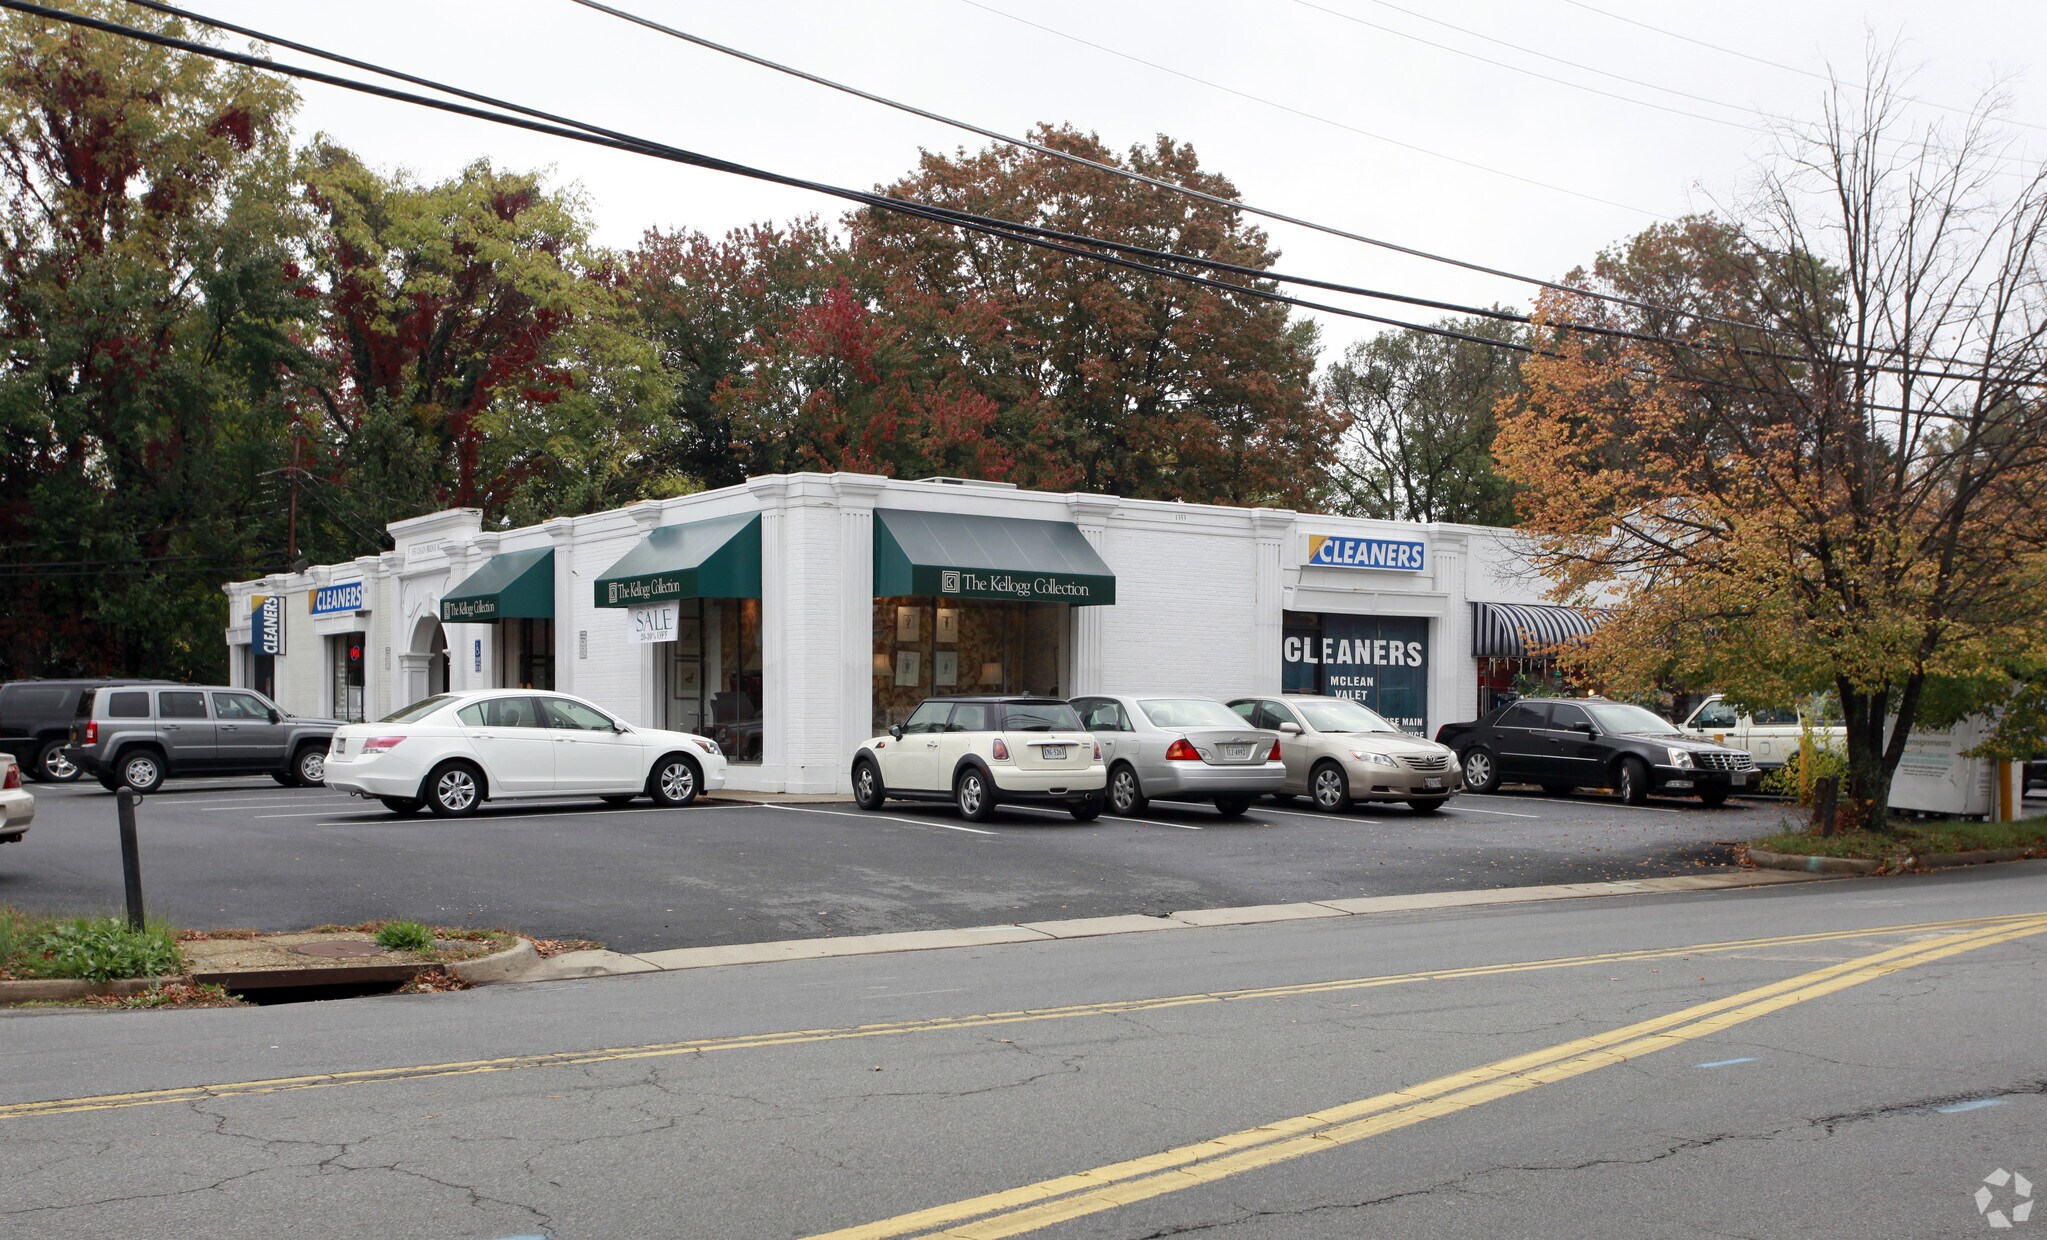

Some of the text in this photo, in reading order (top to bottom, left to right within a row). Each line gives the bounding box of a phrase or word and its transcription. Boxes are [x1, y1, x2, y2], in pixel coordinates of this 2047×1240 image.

[1319, 538, 1423, 568] CLEANERS
[617, 578, 680, 600] The Kellogg Collection
[962, 573, 988, 591] The
[990, 575, 1031, 597] Kellogg
[1033, 577, 1090, 597] Collection
[316, 585, 362, 611] CLEANERS
[450, 602, 459, 616] The
[473, 599, 495, 614] Collection
[263, 596, 279, 654] CLEANERS
[636, 608, 673, 632] SALE
[656, 631, 669, 640] OFF
[1284, 636, 1423, 667] CLEANERS
[1330, 676, 1374, 687] MCLEAN
[1335, 689, 1368, 701] VALET
[1402, 717, 1423, 727] MAIN
[1905, 739, 1952, 748] onsignments
